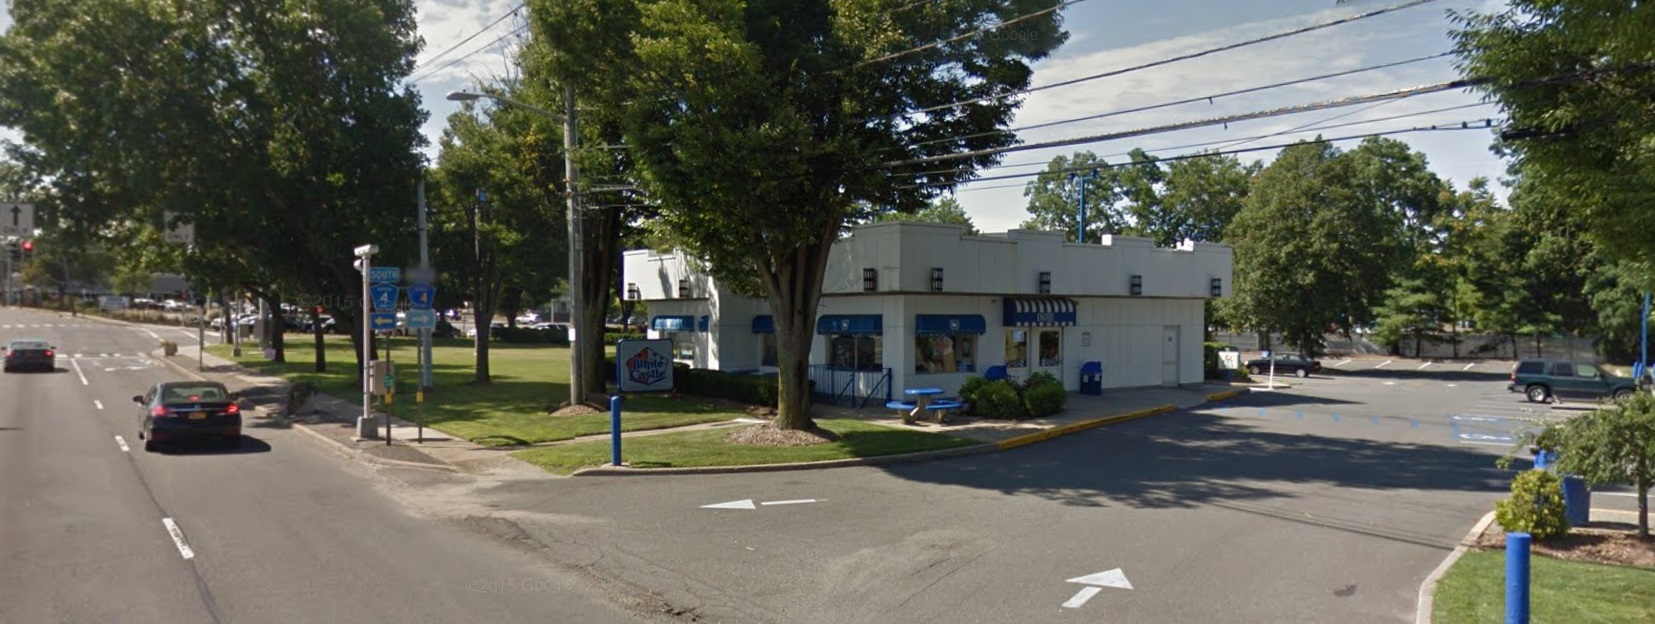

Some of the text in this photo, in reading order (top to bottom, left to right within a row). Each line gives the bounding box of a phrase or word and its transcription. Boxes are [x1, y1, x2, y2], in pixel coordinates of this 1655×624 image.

[370, 270, 399, 279] SOUTH
[420, 292, 428, 303] 4
[634, 357, 664, 369] White
[630, 368, 666, 380] Castle
